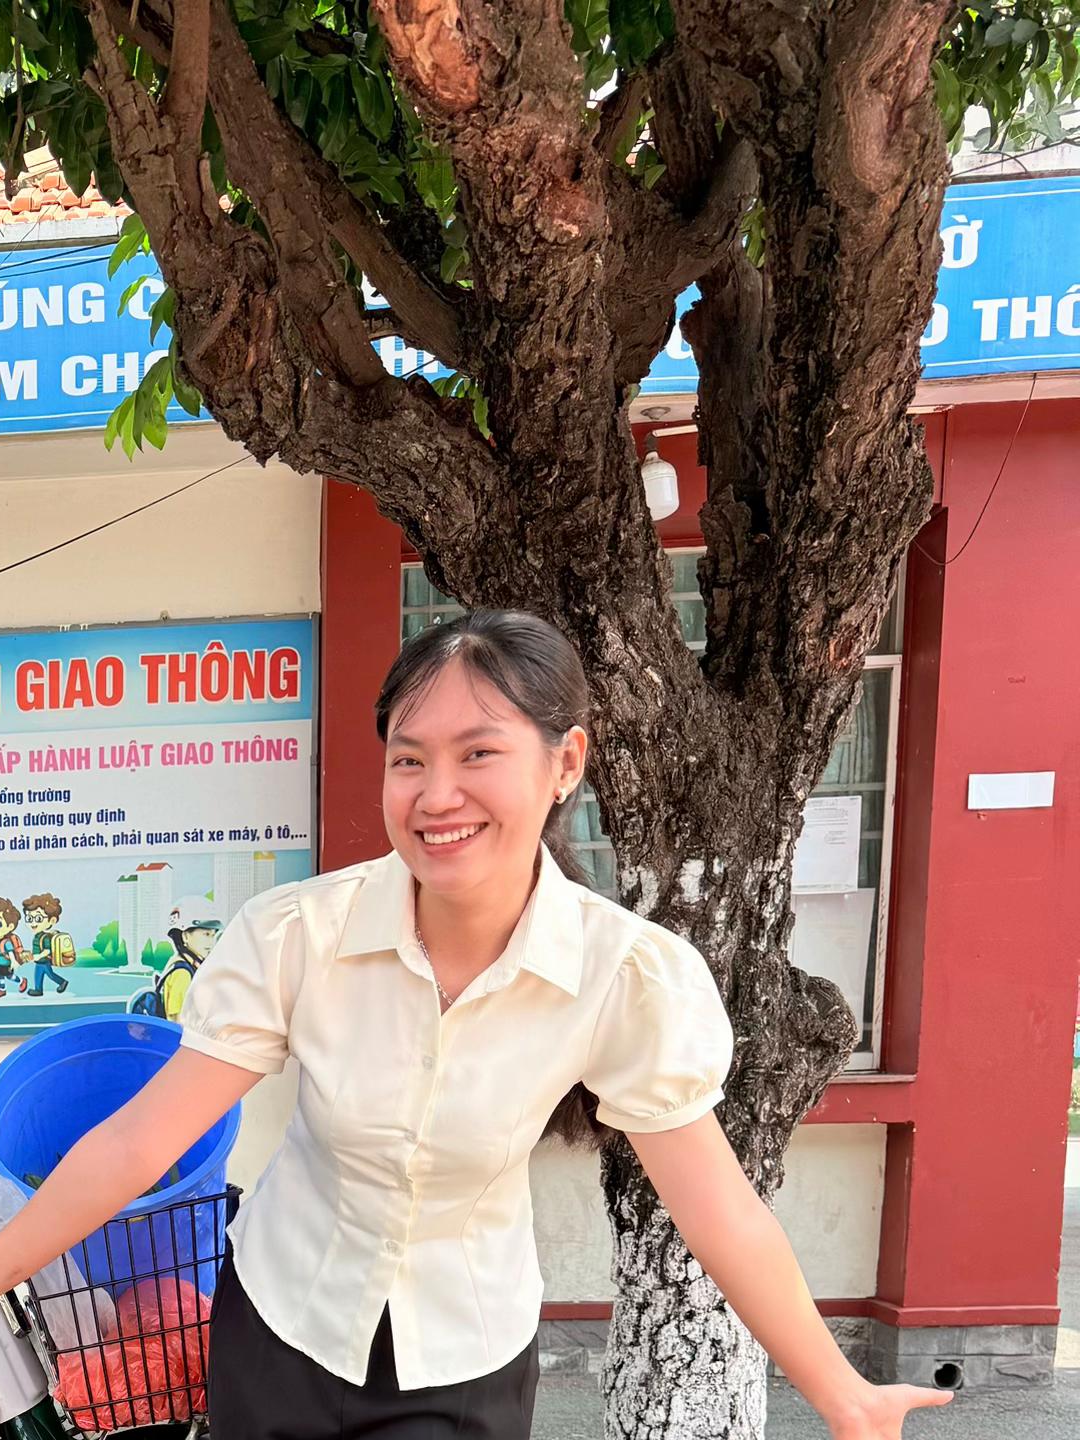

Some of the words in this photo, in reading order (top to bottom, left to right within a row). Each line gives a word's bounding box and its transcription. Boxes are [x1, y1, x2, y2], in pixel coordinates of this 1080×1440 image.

[16, 656, 124, 712] GIAO
[140, 641, 299, 704] THÔNG
[29, 744, 91, 773] HÀNH
[98, 740, 153, 772] LUẬT
[161, 741, 213, 766] GIAO
[221, 735, 299, 764] THÔNG
[28, 788, 71, 803] trường
[0, 813, 19, 827] làn
[23, 812, 64, 827] đường
[69, 812, 92, 826] quy
[96, 808, 126, 826] định
[10, 834, 30, 850] dải
[35, 835, 67, 851] phân
[72, 832, 108, 848] cách,
[112, 829, 142, 847] phải
[146, 831, 179, 846] quan
[183, 828, 204, 843] sát
[208, 830, 224, 842] xe
[229, 826, 260, 842] máy,
[265, 825, 273, 839] ô
